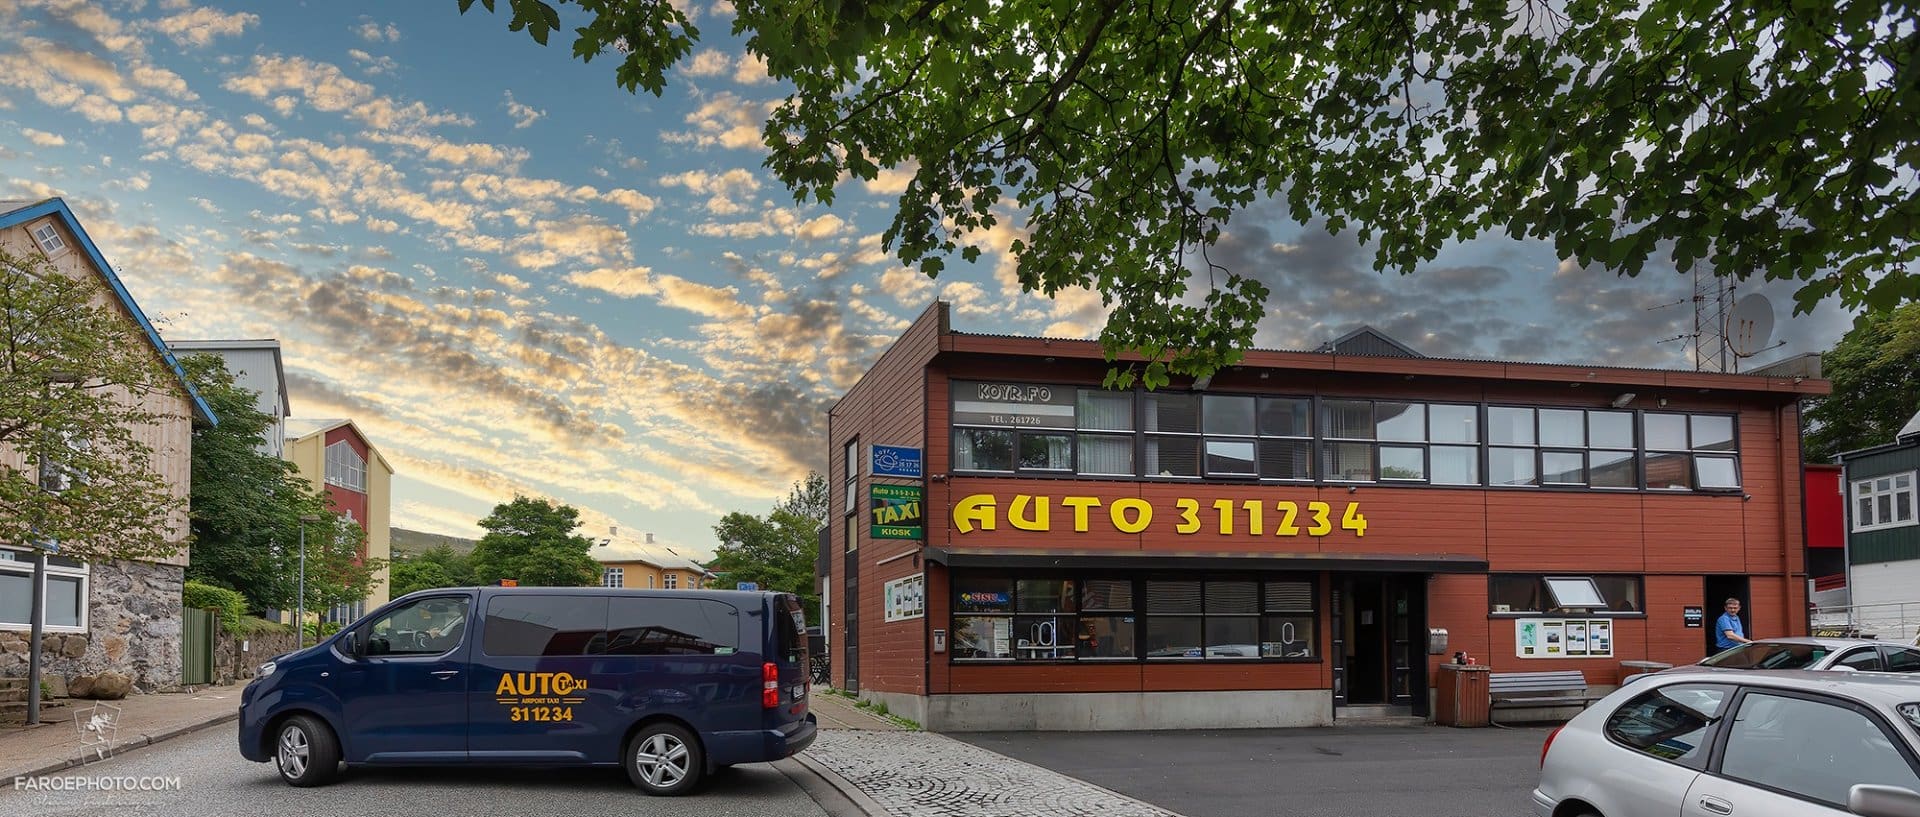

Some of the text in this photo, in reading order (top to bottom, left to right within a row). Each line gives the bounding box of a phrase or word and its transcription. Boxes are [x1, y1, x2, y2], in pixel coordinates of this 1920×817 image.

[977, 383, 1052, 402] KOYR.FO
[990, 415, 1041, 425] TEL. 261726
[872, 502, 921, 525] TAXI
[953, 494, 1368, 537] AUTO 311234
[881, 528, 912, 536] KIOSK
[495, 672, 588, 696] AUTO TAXI
